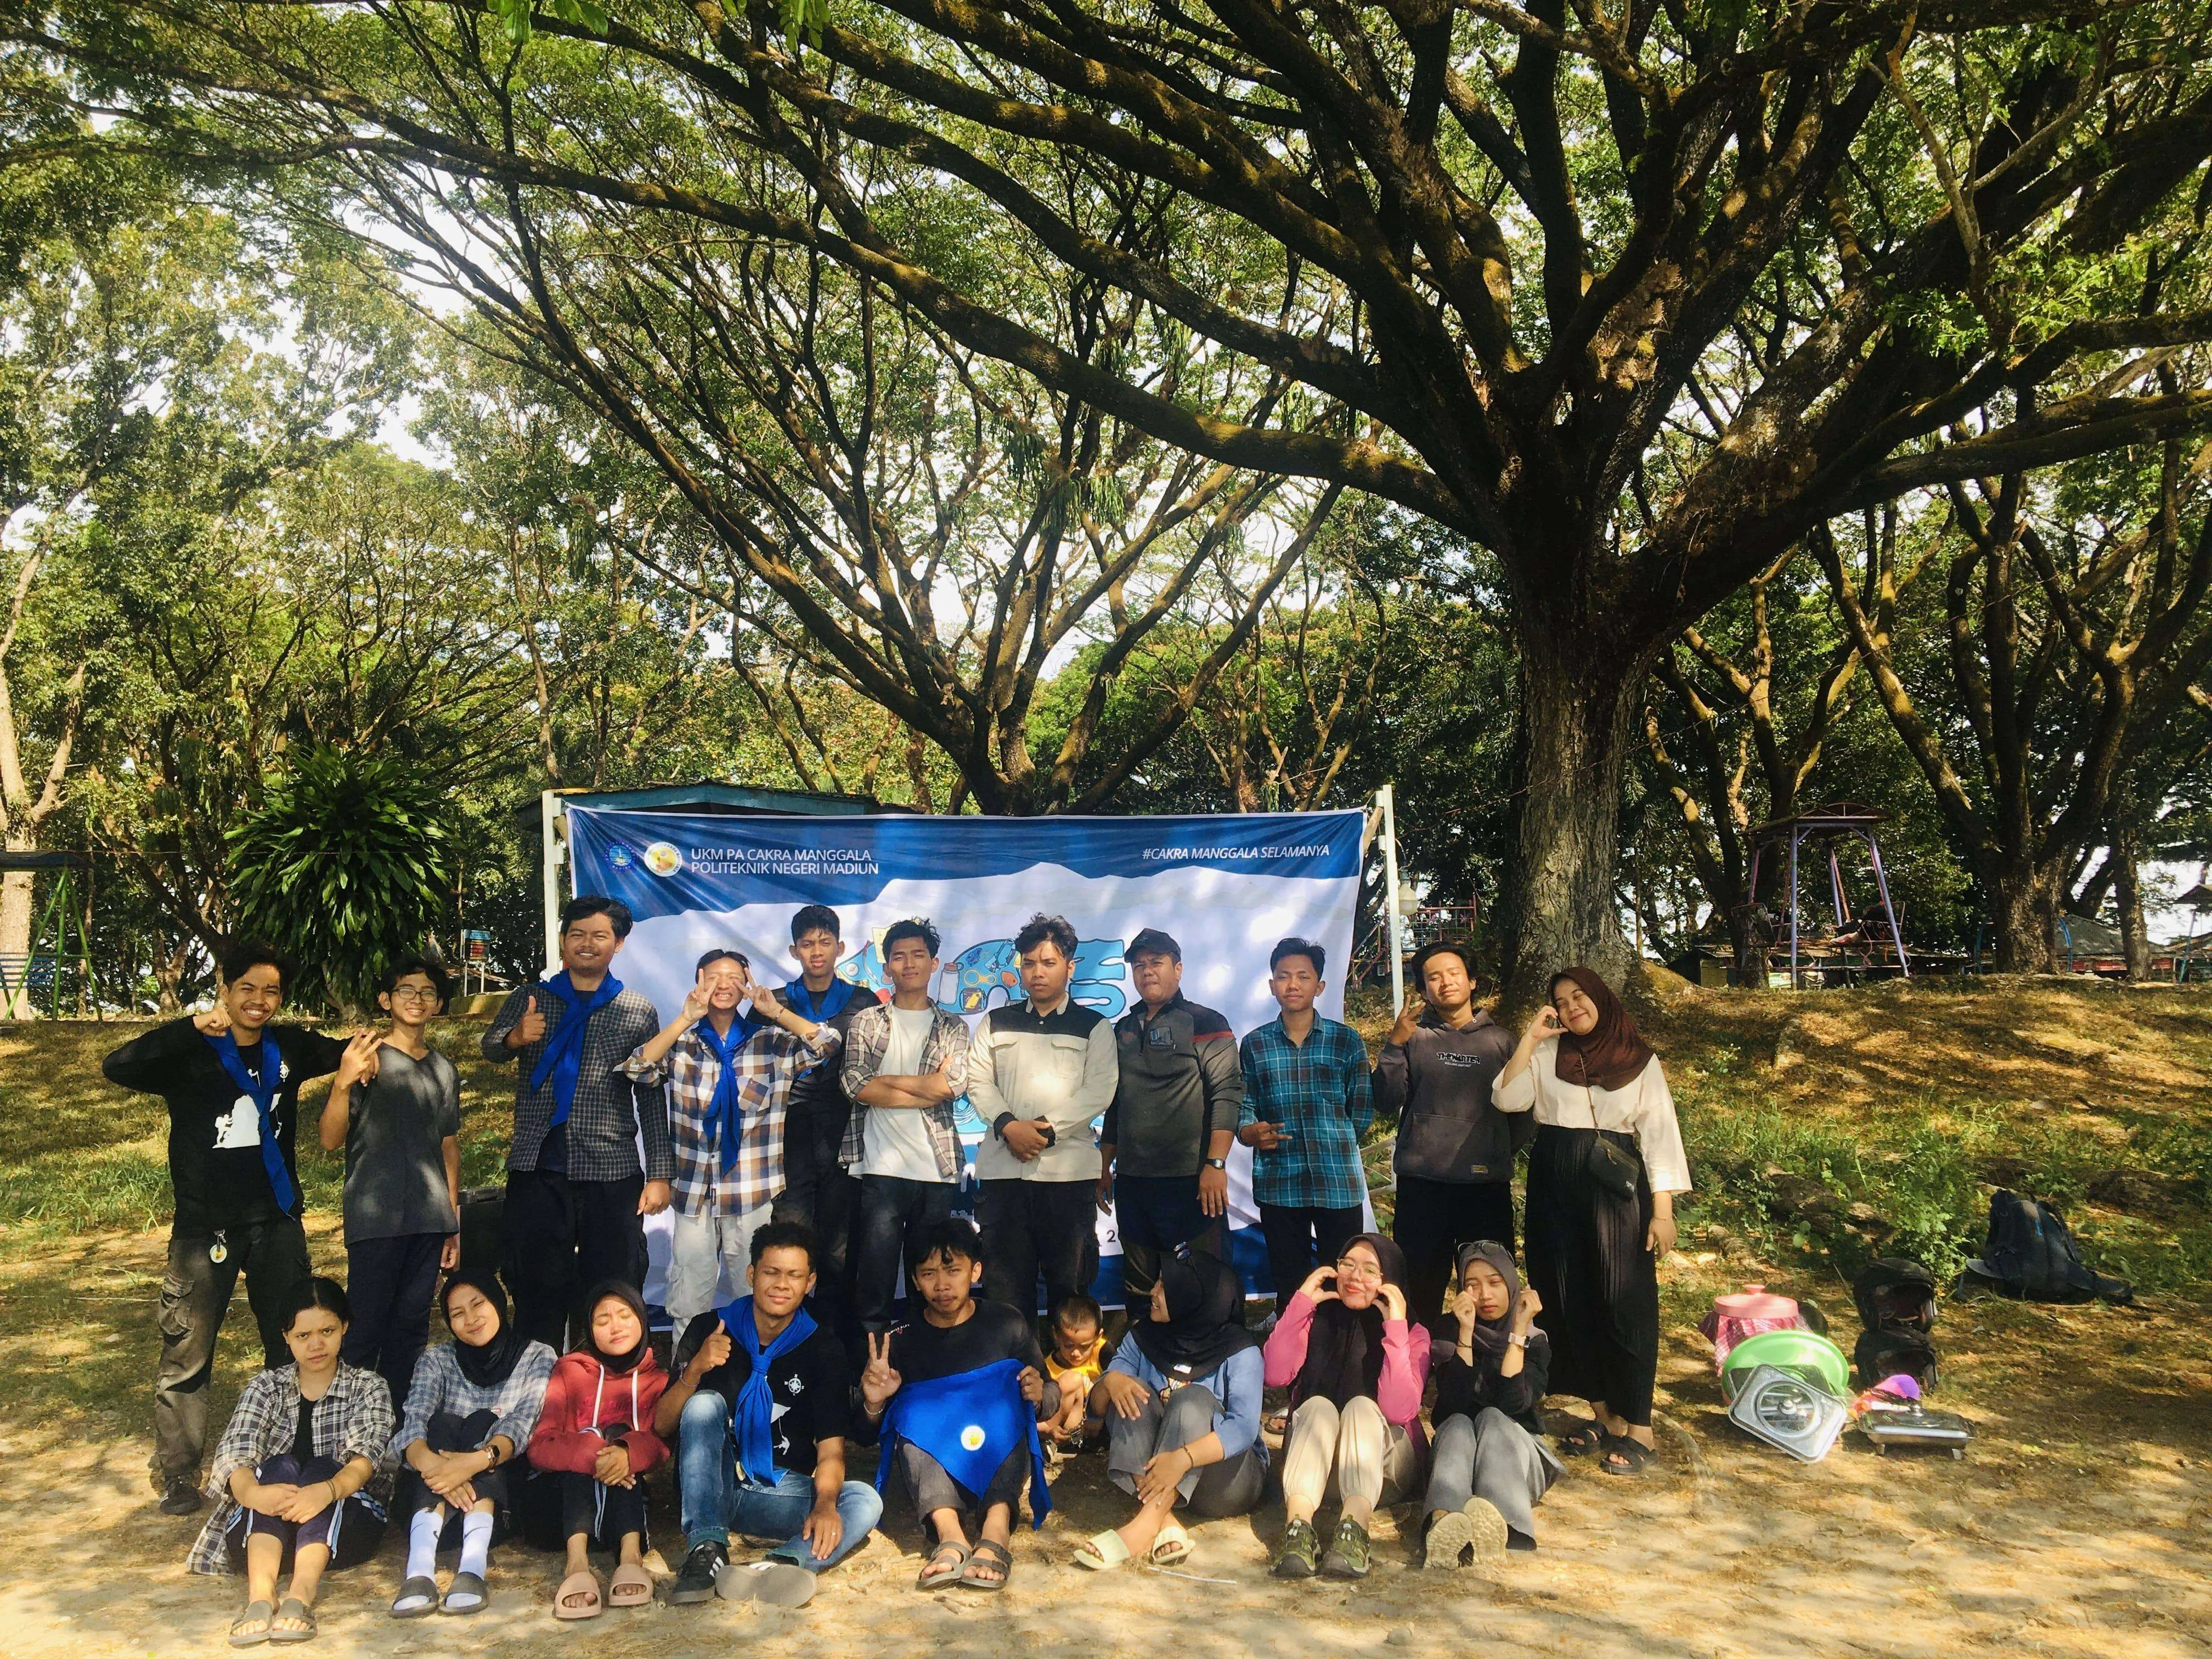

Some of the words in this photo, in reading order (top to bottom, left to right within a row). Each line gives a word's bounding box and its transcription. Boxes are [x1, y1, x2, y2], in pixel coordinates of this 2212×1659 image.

[691, 849, 723, 860] UKM
[727, 849, 744, 860] PA
[747, 849, 792, 861] CAKRA
[795, 850, 871, 861] MANGGALA
[1142, 849, 1189, 860] #CAKRA
[1191, 848, 1258, 859] MANGGALA
[1261, 845, 1330, 858] SELAMANYA
[691, 862, 770, 874] POLITEKNIK
[773, 863, 820, 874] NEGERI
[823, 863, 878, 874] MADIUN
